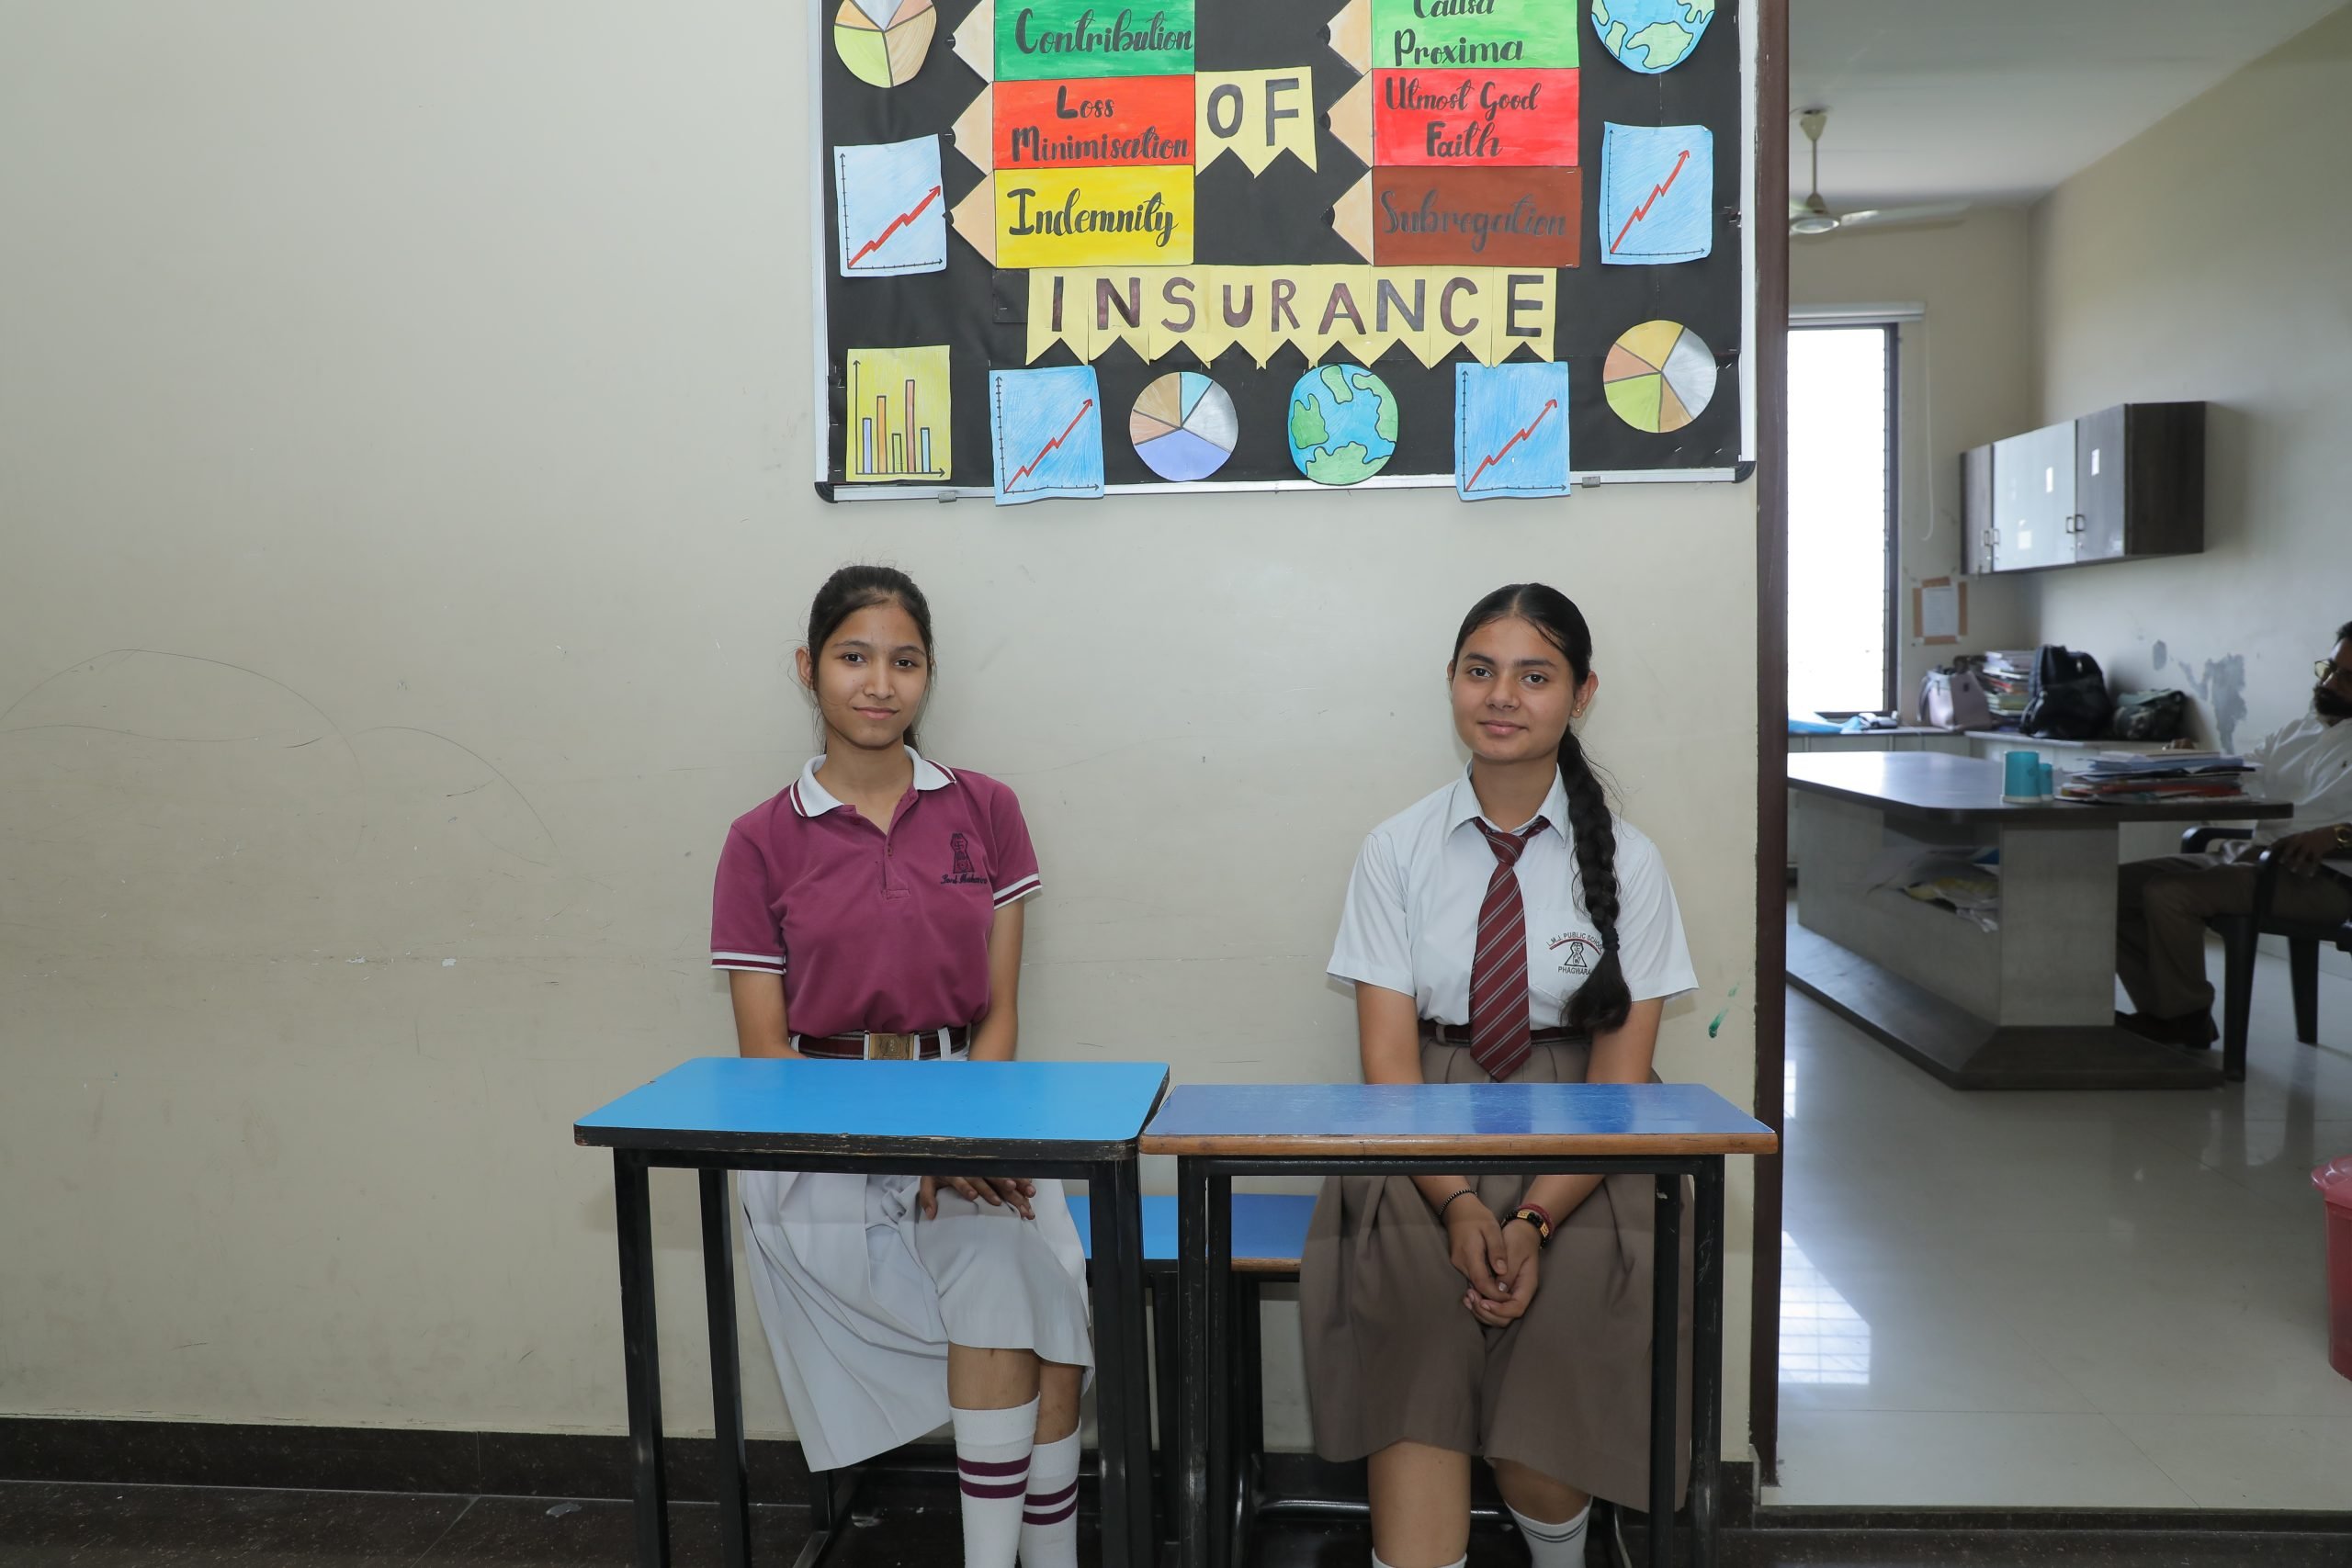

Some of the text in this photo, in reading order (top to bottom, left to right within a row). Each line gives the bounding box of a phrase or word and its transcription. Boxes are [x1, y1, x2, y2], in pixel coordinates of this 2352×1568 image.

[1014, 8, 1193, 54] Contribution
[1394, 28, 1523, 67] Proxima
[1056, 85, 1115, 119] Loss
[1206, 77, 1300, 147] OF
[1385, 77, 1542, 120] Utmost Good
[1012, 125, 1191, 163] Minimisation
[1426, 120, 1504, 158] Faith
[1006, 187, 1180, 248] Indemnity
[1051, 274, 1544, 337] INSURANCE
